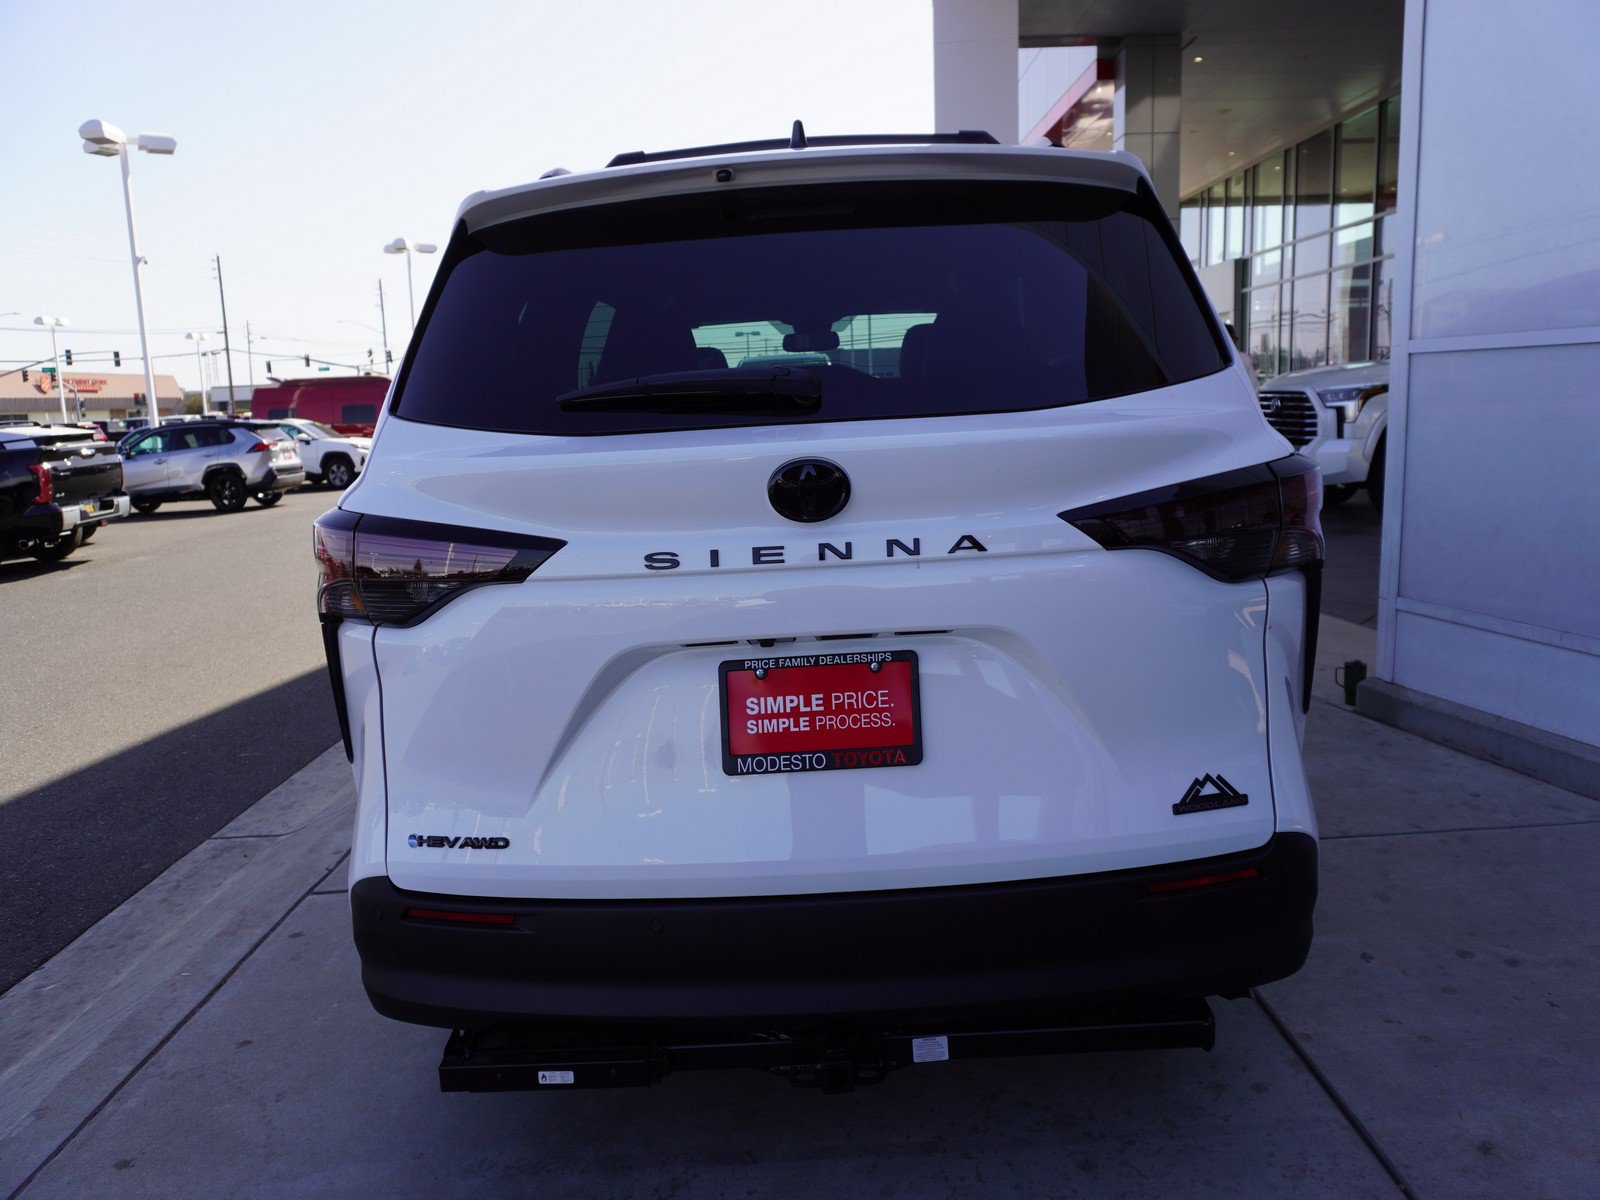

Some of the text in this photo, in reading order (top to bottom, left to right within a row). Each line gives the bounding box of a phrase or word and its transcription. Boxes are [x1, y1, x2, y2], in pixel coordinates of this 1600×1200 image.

[643, 534, 988, 570] SIENNA
[744, 652, 892, 670] PRICE FAMILY DEALERSHIPS
[745, 689, 895, 715] SIMPLE PRICE.
[746, 711, 896, 735] SIMPLE PROCESS.
[737, 749, 908, 773] MODESTO TOYOTA
